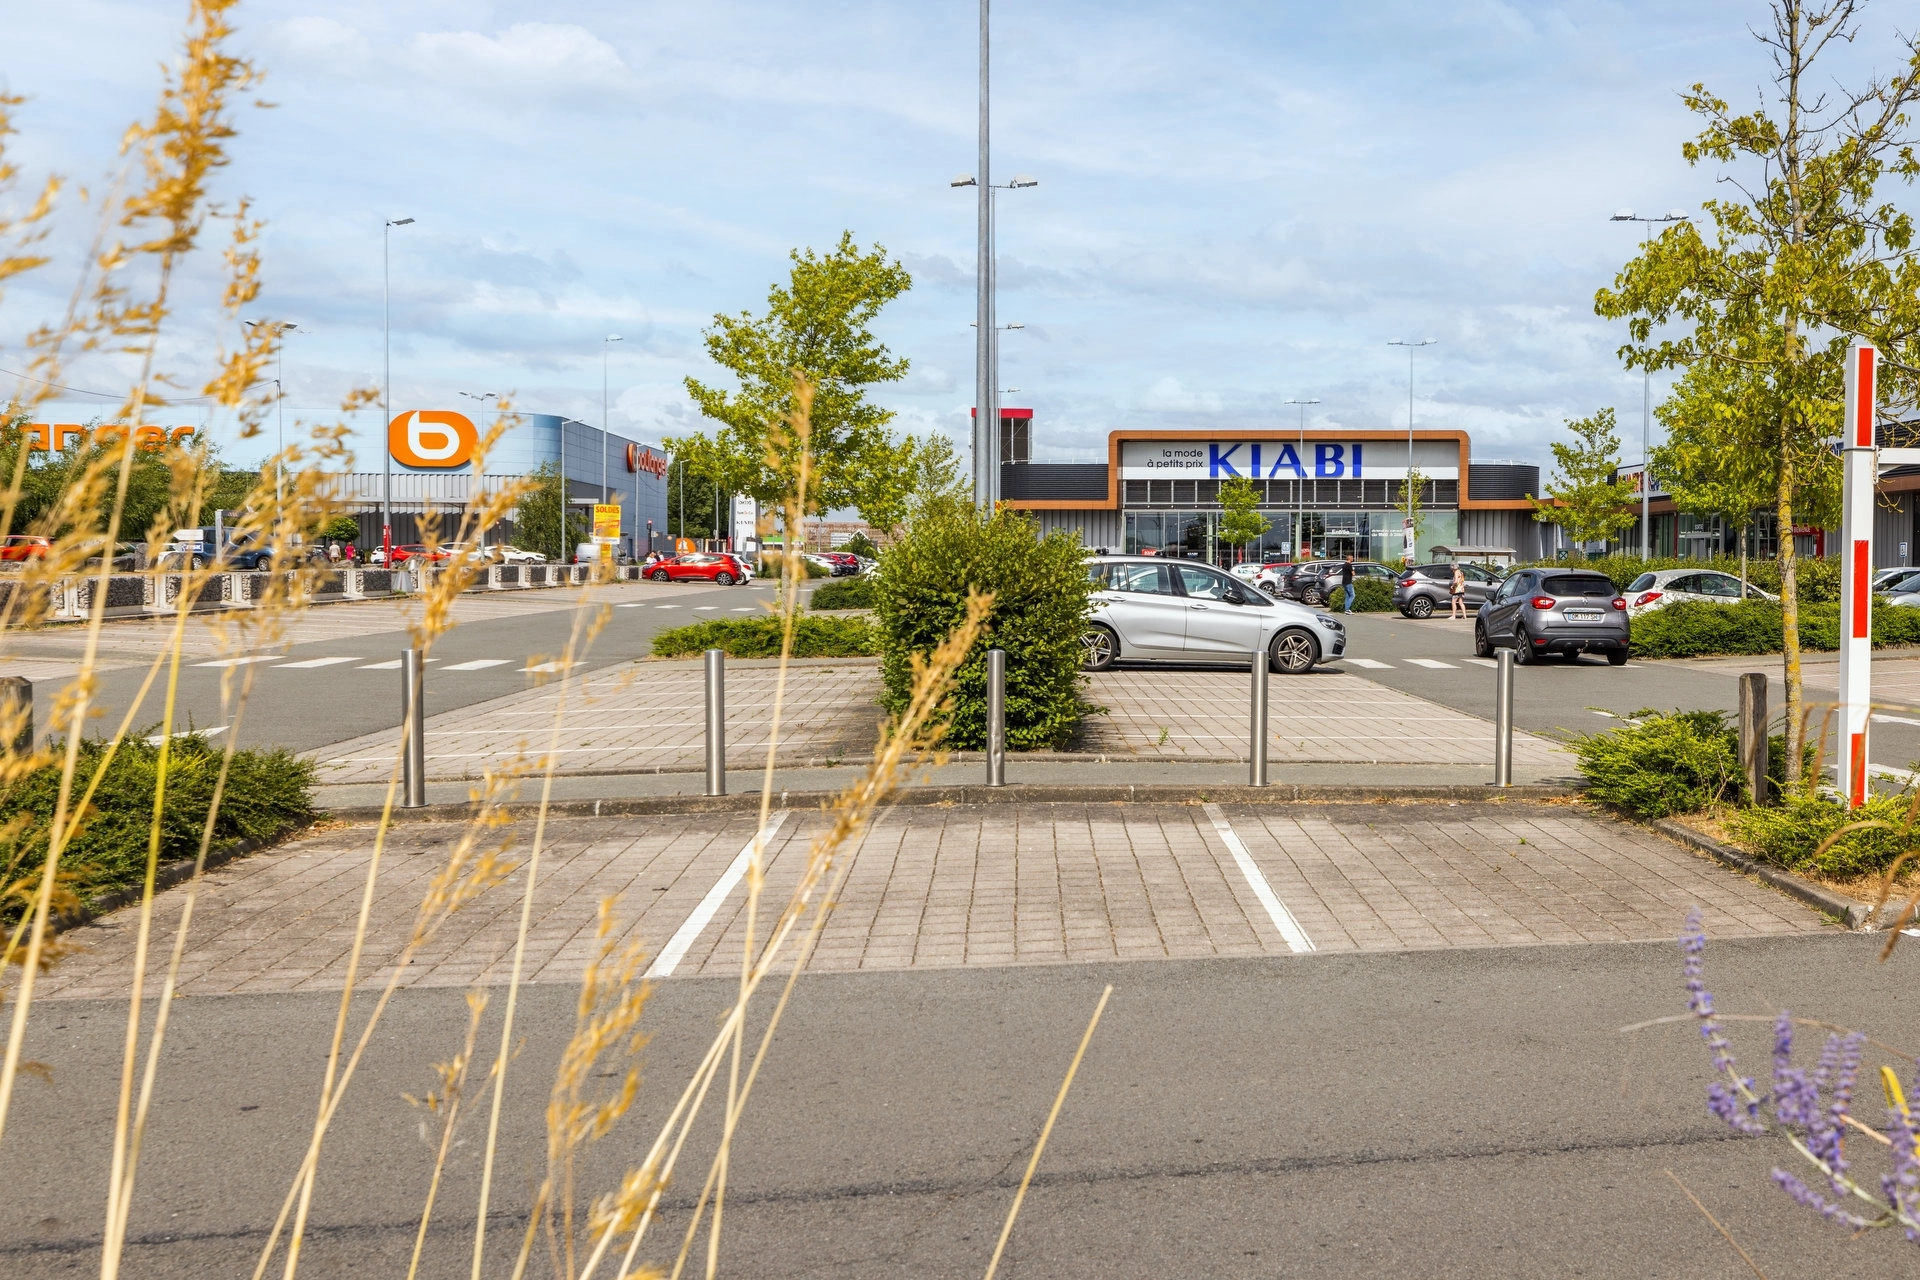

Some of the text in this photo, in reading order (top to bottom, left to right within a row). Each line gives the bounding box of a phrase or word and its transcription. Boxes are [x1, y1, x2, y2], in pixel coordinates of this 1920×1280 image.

[407, 410, 460, 460] b
[1162, 449, 1203, 458] la mode
[1147, 459, 1204, 469] à petits prix
[1209, 443, 1363, 478] KIABI
[595, 505, 620, 514] SOLDES
